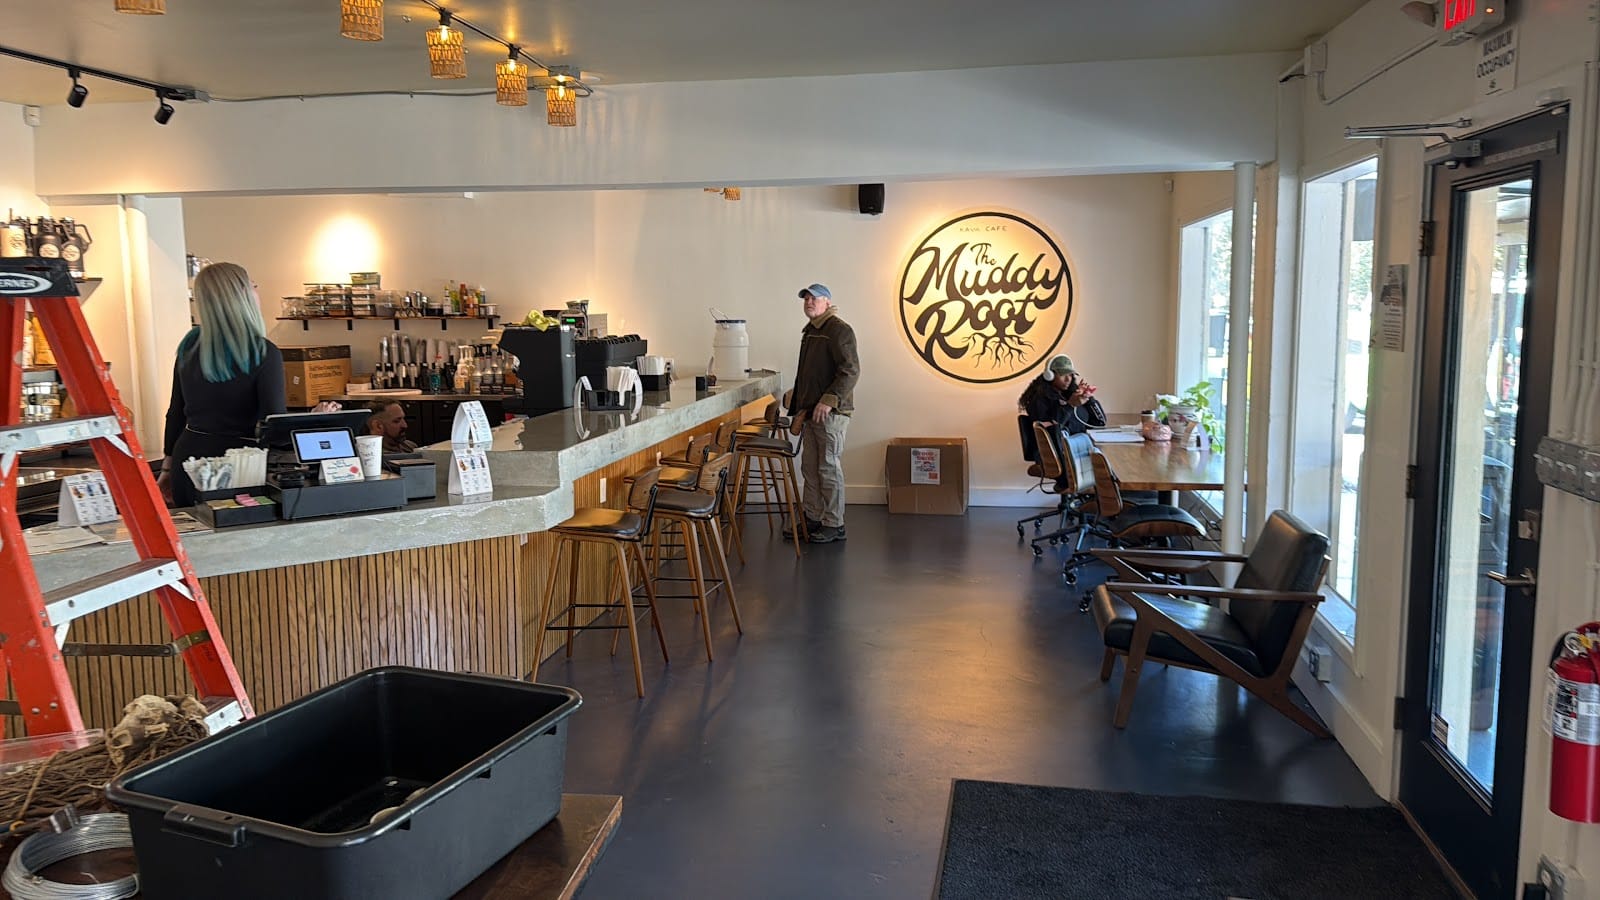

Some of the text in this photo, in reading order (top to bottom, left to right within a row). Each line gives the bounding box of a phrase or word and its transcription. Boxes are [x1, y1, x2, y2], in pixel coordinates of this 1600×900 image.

[1483, 29, 1513, 56] MAXIMUM
[1477, 49, 1516, 78] OCCUPANCY
[970, 243, 997, 267] The
[903, 242, 1065, 310] Muddy
[914, 292, 1038, 360] Root
